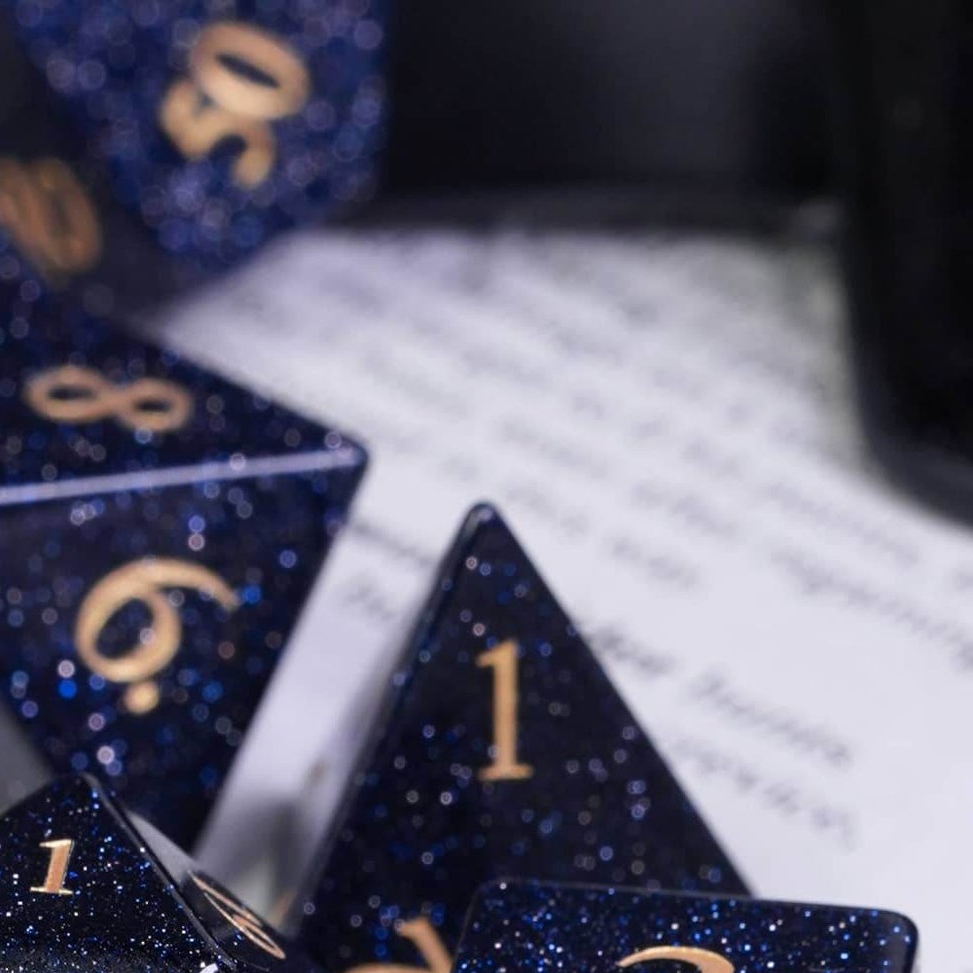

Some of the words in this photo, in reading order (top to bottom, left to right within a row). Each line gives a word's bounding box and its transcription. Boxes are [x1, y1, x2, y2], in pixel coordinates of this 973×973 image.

[160, 22, 311, 188] 50
[27, 366, 193, 432] 8
[476, 638, 533, 781] 1
[30, 838, 75, 896] 1
